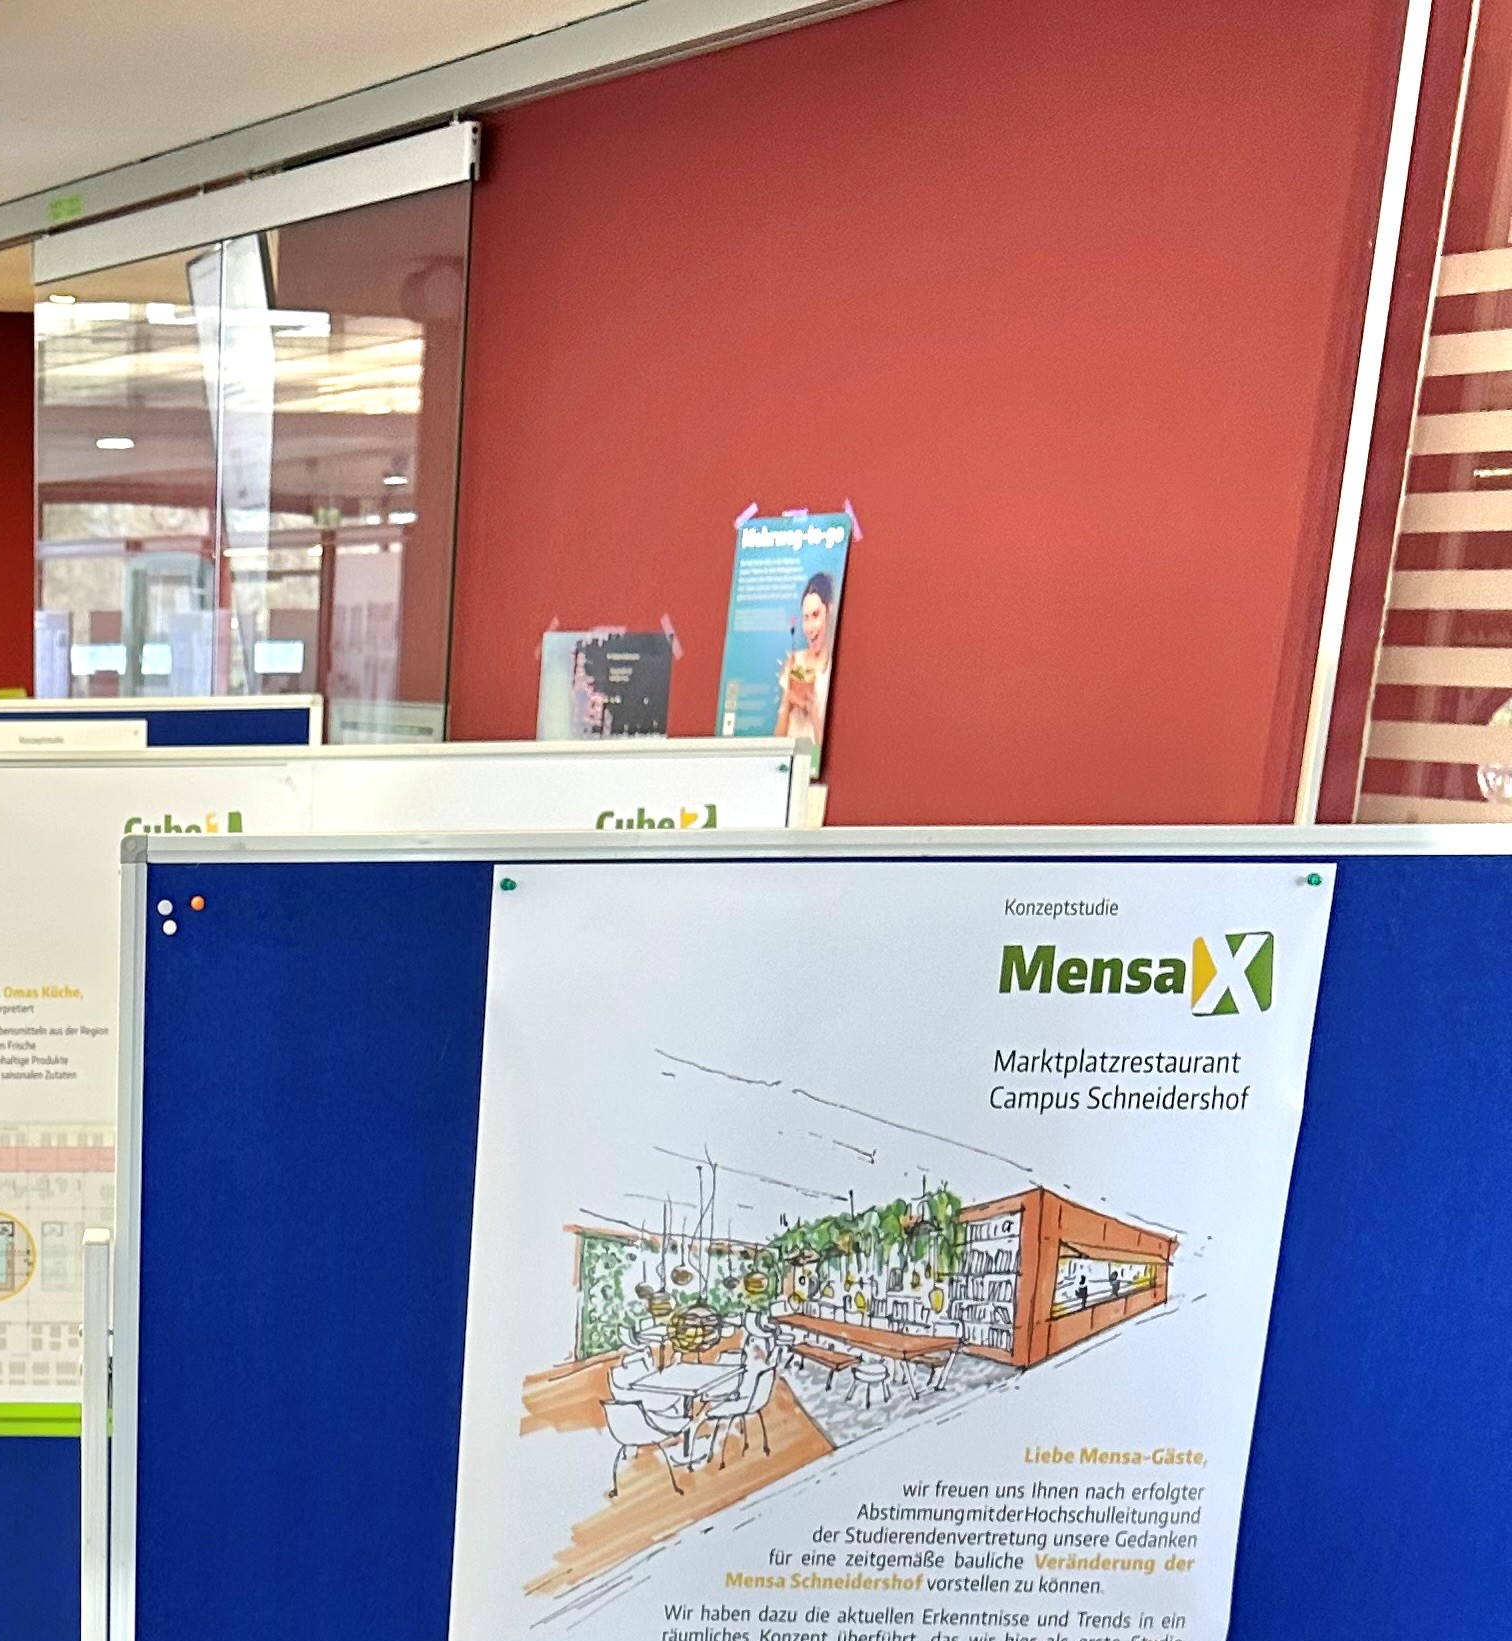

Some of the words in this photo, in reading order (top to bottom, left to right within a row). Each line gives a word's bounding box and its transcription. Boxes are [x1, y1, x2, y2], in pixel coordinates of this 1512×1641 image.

[1004, 897, 1119, 921] Konzeptstudie
[2, 984, 41, 1000] Omas
[39, 984, 84, 1001] Küche,
[993, 1047, 1242, 1080] Marktplatzrestaurant
[989, 1085, 1081, 1116] Campus
[1086, 1084, 1251, 1111] Schneidershof
[1023, 1445, 1077, 1465] Liebe
[1079, 1446, 1208, 1467] Mensa-Gäste,
[902, 1479, 931, 1498] wir
[935, 1479, 989, 1499] freuen
[995, 1485, 1026, 1500] uns
[1031, 1480, 1079, 1500] Ihnen
[1085, 1481, 1126, 1501] nach
[1131, 1481, 1205, 1505] erfolgter
[812, 1525, 841, 1544] der
[844, 1525, 1048, 1551] Studierendenvertretung
[1052, 1533, 1110, 1548] unsere
[1114, 1529, 1198, 1549] Gedanken
[768, 1547, 793, 1567] für
[801, 1549, 837, 1567] eine
[845, 1549, 945, 1572] zeitgemäße
[954, 1550, 1024, 1571] bauliche
[1034, 1552, 1157, 1575] Veränderung
[1163, 1553, 1196, 1572] der
[724, 1571, 788, 1590] Mensa
[789, 1571, 925, 1591] Schneidershof
[926, 1573, 1010, 1593] vorstellen
[1013, 1579, 1034, 1594] zu
[1038, 1575, 1105, 1595] können.
[664, 1603, 695, 1622] Wir
[700, 1603, 752, 1623] haben
[758, 1604, 798, 1624] dazu
[804, 1605, 831, 1624] die
[836, 1605, 915, 1625] aktuellen
[921, 1607, 1030, 1628] Erkenntnisse
[1037, 1609, 1070, 1628] und
[1076, 1610, 1131, 1630] Trends
[1138, 1611, 1154, 1630] in
[1161, 1612, 1186, 1630] ein
